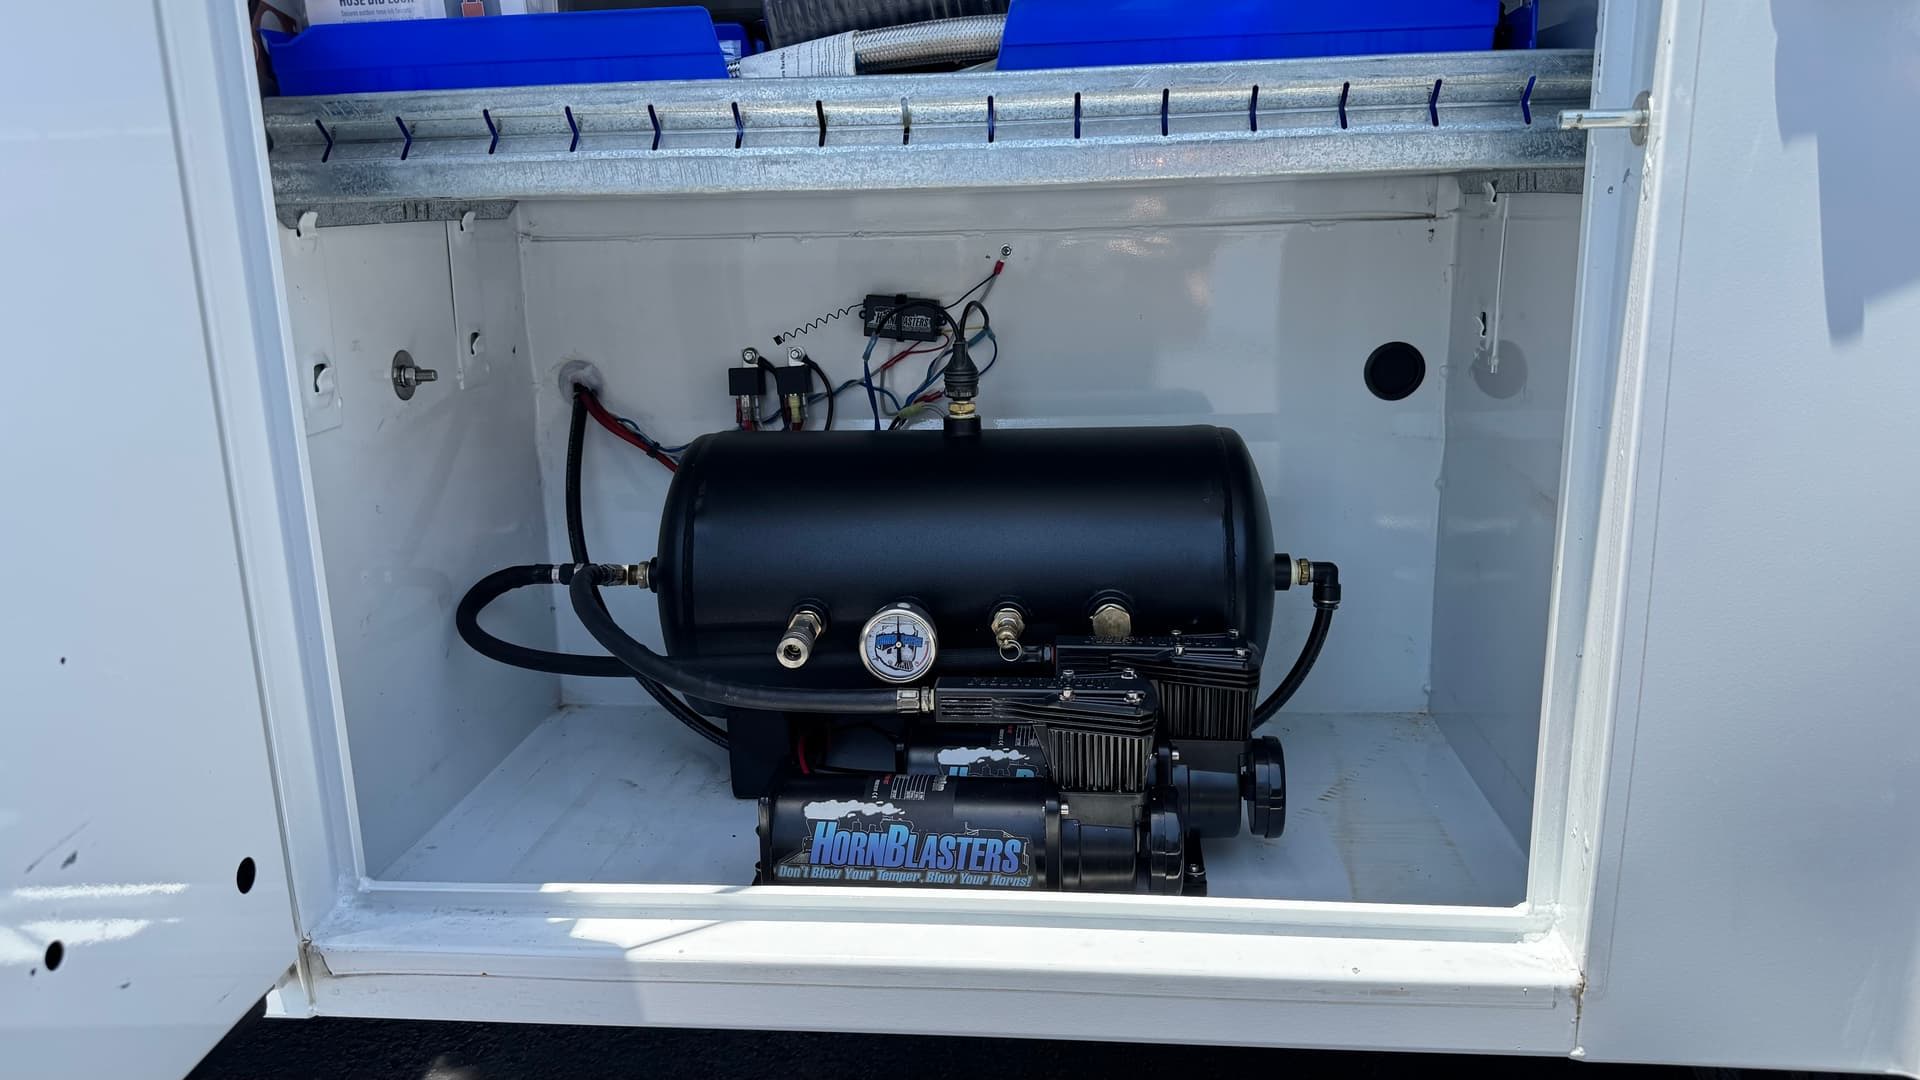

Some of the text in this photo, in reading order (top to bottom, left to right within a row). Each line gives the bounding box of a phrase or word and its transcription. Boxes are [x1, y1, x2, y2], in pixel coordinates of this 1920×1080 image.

[778, 865, 809, 878] Don't
[811, 867, 841, 880] Blow
[845, 868, 872, 880] Your
[926, 871, 956, 884] Blow
[960, 873, 988, 885] Your
[990, 874, 1032, 888] Horns!
